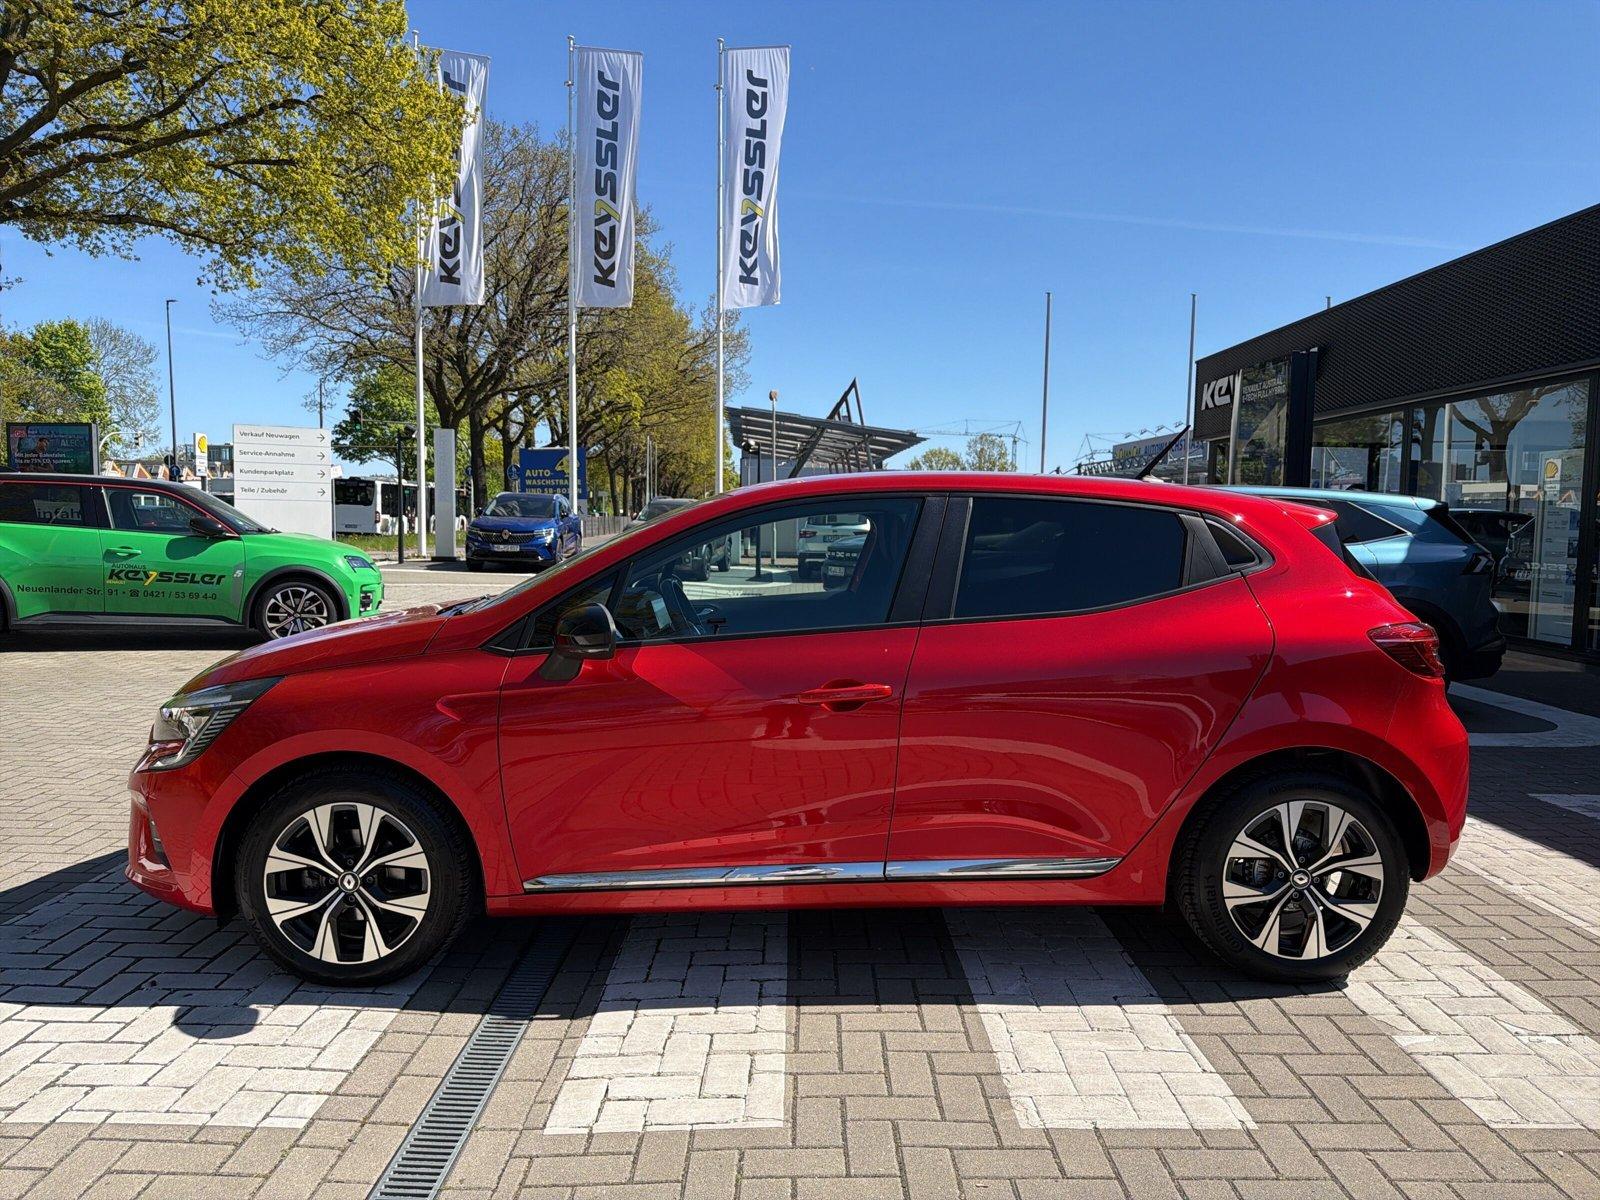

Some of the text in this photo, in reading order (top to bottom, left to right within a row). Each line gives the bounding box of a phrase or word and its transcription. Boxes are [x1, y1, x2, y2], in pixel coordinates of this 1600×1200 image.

[265, 432, 300, 440] Neuwagen
[239, 449, 295, 458] Service-Annahme
[17, 584, 83, 594] Neuenlander
[86, 587, 103, 595] Str.
[108, 588, 119, 596] 91
[143, 590, 165, 598] 0421
[175, 591, 185, 599] 53
[189, 592, 200, 600] 69
